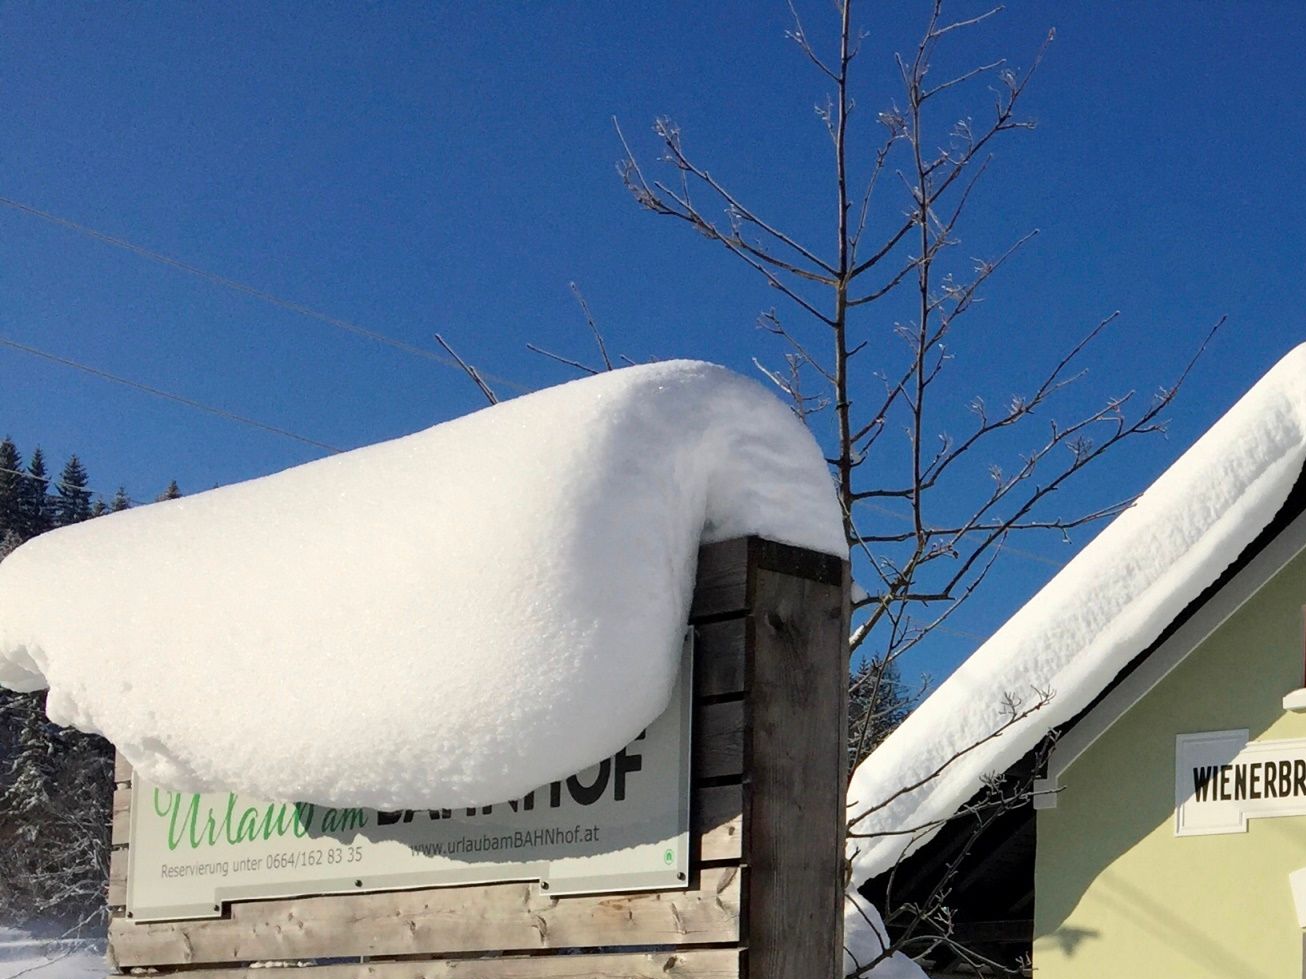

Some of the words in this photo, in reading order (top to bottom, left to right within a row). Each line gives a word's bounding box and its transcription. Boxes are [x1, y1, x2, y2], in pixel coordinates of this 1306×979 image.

[321, 806, 369, 833] am
[410, 825, 600, 857] www.urlaubamBAHNhof.at
[161, 859, 229, 879] Reservierung
[233, 857, 263, 873] unter
[266, 851, 323, 869] 0664/162
[327, 848, 343, 865] 83
[347, 847, 363, 863] 35
